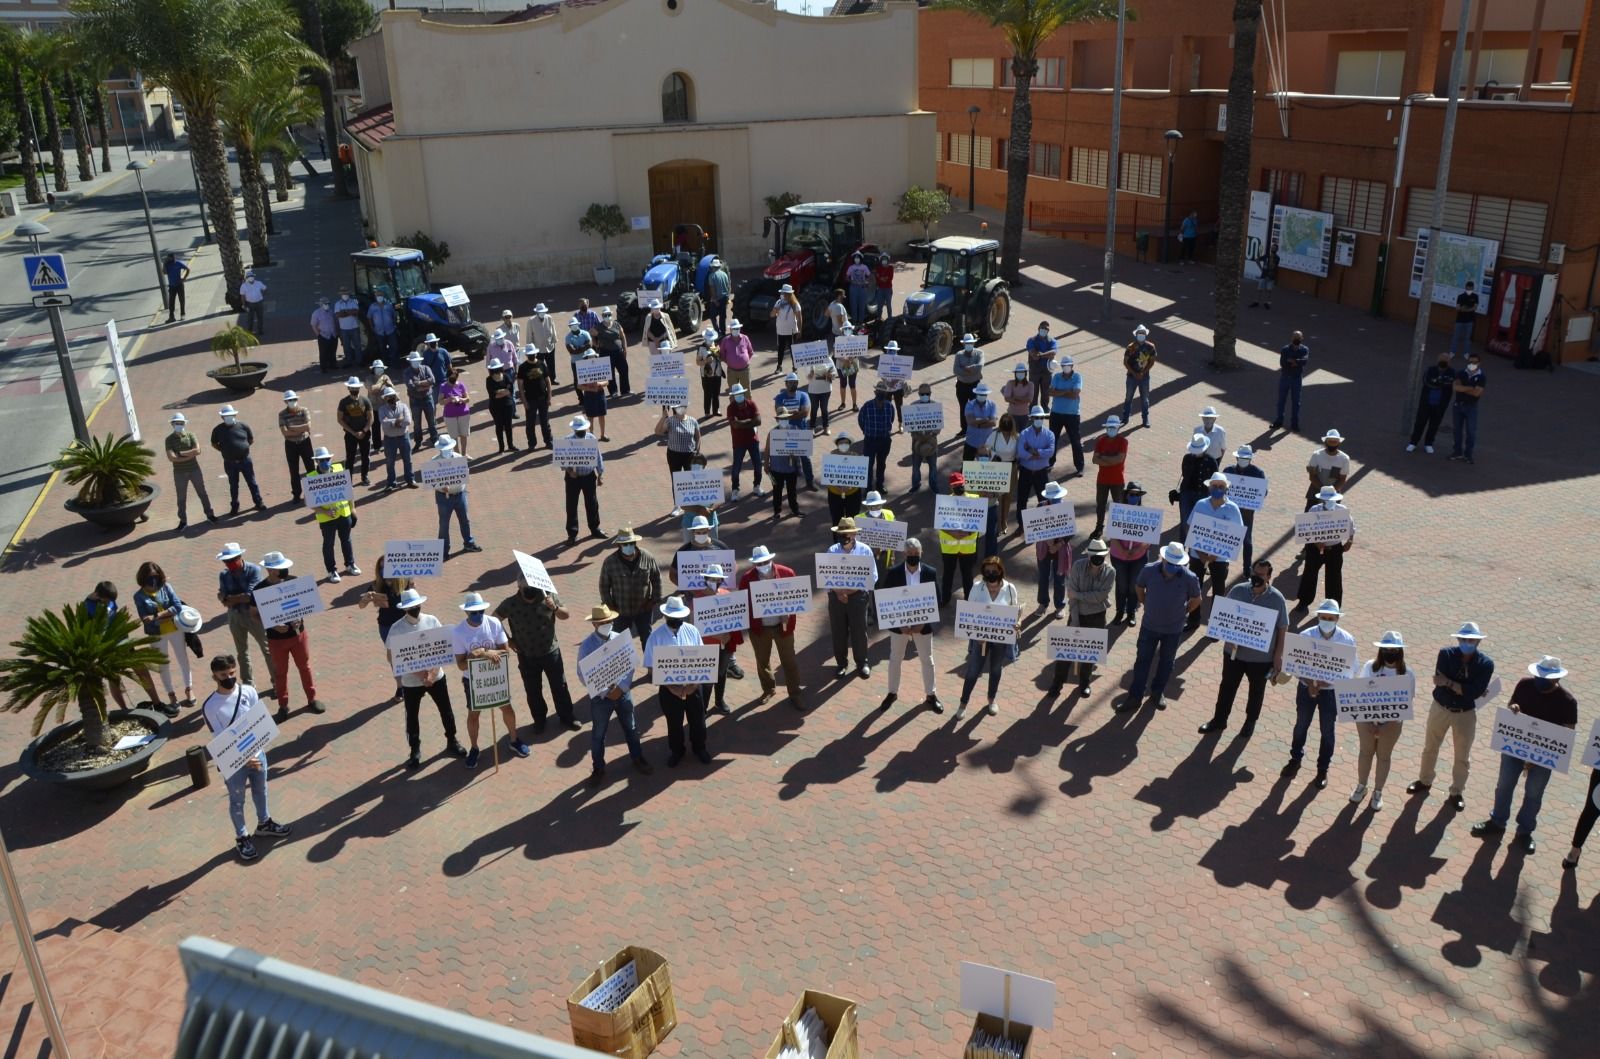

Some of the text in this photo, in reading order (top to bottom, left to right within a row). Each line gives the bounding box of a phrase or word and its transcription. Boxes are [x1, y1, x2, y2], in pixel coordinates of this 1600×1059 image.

[316, 494, 345, 504] AGUA
[684, 494, 717, 502] AGUA
[1112, 521, 1149, 530] DESIERTO
[1194, 542, 1230, 558] AGUA
[825, 580, 865, 588] AGUA
[762, 606, 806, 615] AGUA
[881, 608, 934, 620] DESIERTO
[900, 616, 928, 624] PARO
[1218, 612, 1249, 622] MILES
[704, 622, 742, 634] AGUA
[958, 624, 1014, 635] DESIERTO
[1234, 626, 1261, 636] PARO
[976, 633, 1006, 641] PARO
[399, 642, 430, 653] MILES
[420, 649, 446, 658] PARO
[1056, 653, 1098, 662] AGUA
[1294, 648, 1328, 660] MILES
[478, 663, 488, 672] SIN
[1312, 661, 1343, 672] PARO
[476, 675, 506, 689] SE ACABA LA
[476, 690, 508, 704] AGRICULTURA
[1340, 704, 1408, 712] DESIERTO
[1498, 722, 1523, 735] NOS
[1497, 729, 1566, 755] AHOGANDO
[1513, 740, 1530, 750] NO
[1534, 746, 1559, 760] CON
[1502, 744, 1556, 768] AGUA
